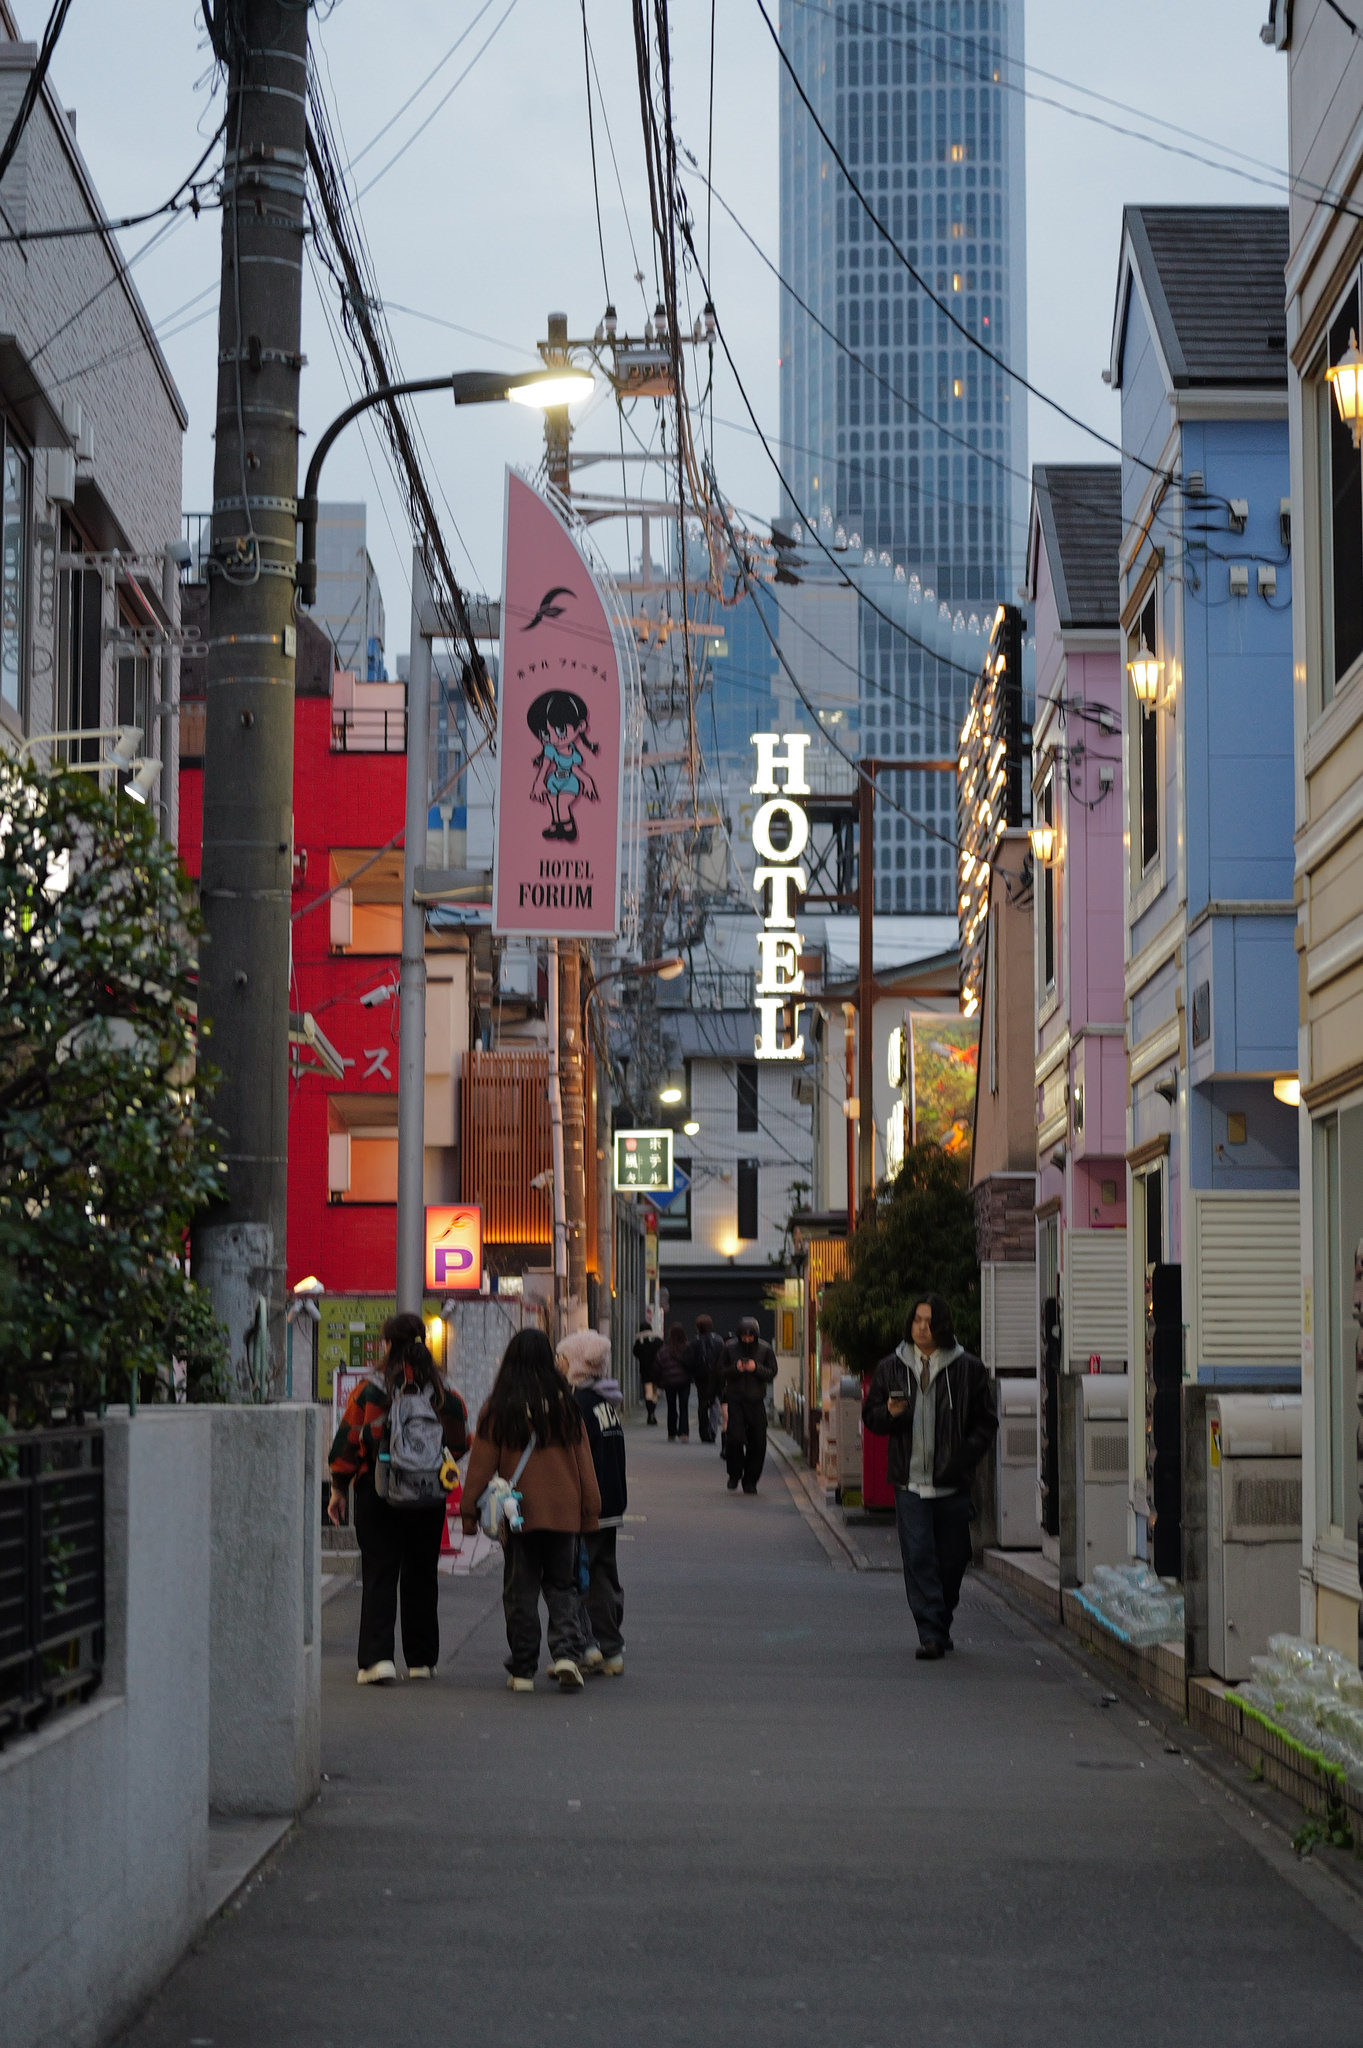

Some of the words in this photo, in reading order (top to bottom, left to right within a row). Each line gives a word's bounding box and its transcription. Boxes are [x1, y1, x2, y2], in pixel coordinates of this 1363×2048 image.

[540, 859, 594, 879] HOTEL
[519, 883, 593, 909] FORUM
[751, 733, 811, 1061] HOTEL
[649, 1137, 662, 1184] ホテル
[434, 1248, 474, 1283] P
